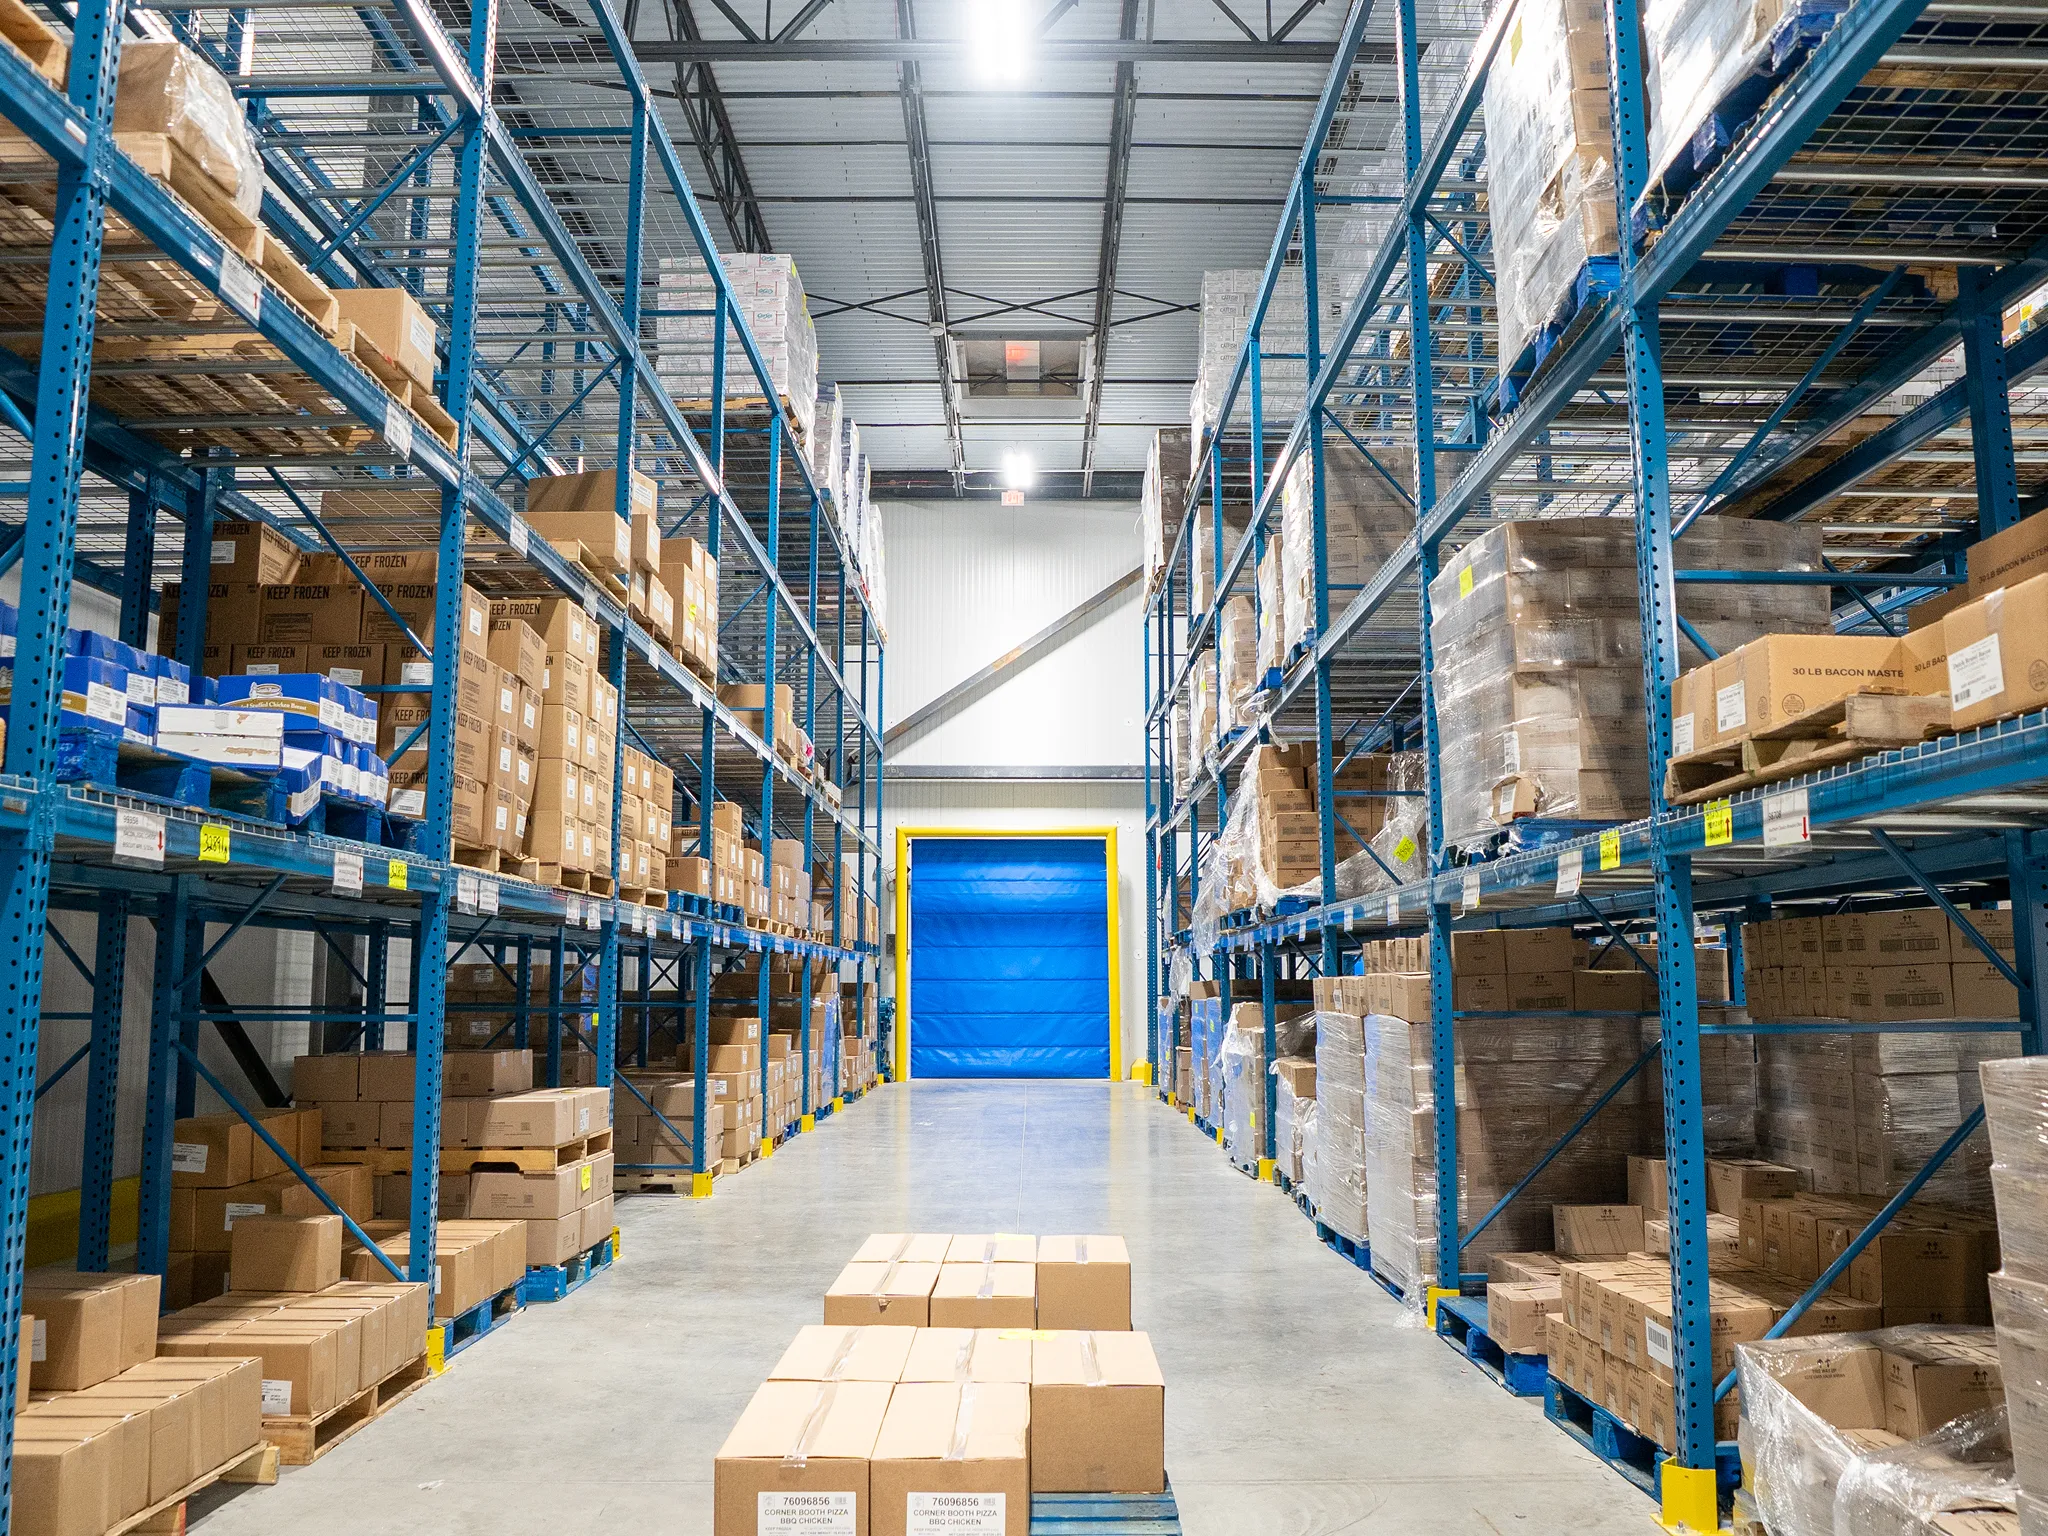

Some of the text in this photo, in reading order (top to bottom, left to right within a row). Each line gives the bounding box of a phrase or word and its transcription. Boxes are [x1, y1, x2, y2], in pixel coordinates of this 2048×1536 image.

[374, 555, 407, 568] FROZEN
[266, 585, 330, 600] KEEP FROZEN
[397, 585, 433, 598] FROZEN
[510, 603, 540, 615] FROZEN
[247, 646, 296, 658] KEEP FROZEN
[322, 646, 372, 658] KEEP FROZEN
[1932, 654, 1947, 667] BACO
[1792, 667, 1904, 678] 30 LB BACON MASTE
[395, 709, 414, 721] KEEP
[389, 772, 409, 784] KEEP
[783, 1497, 830, 1505] 76096856
[932, 1497, 979, 1506] 76096856
